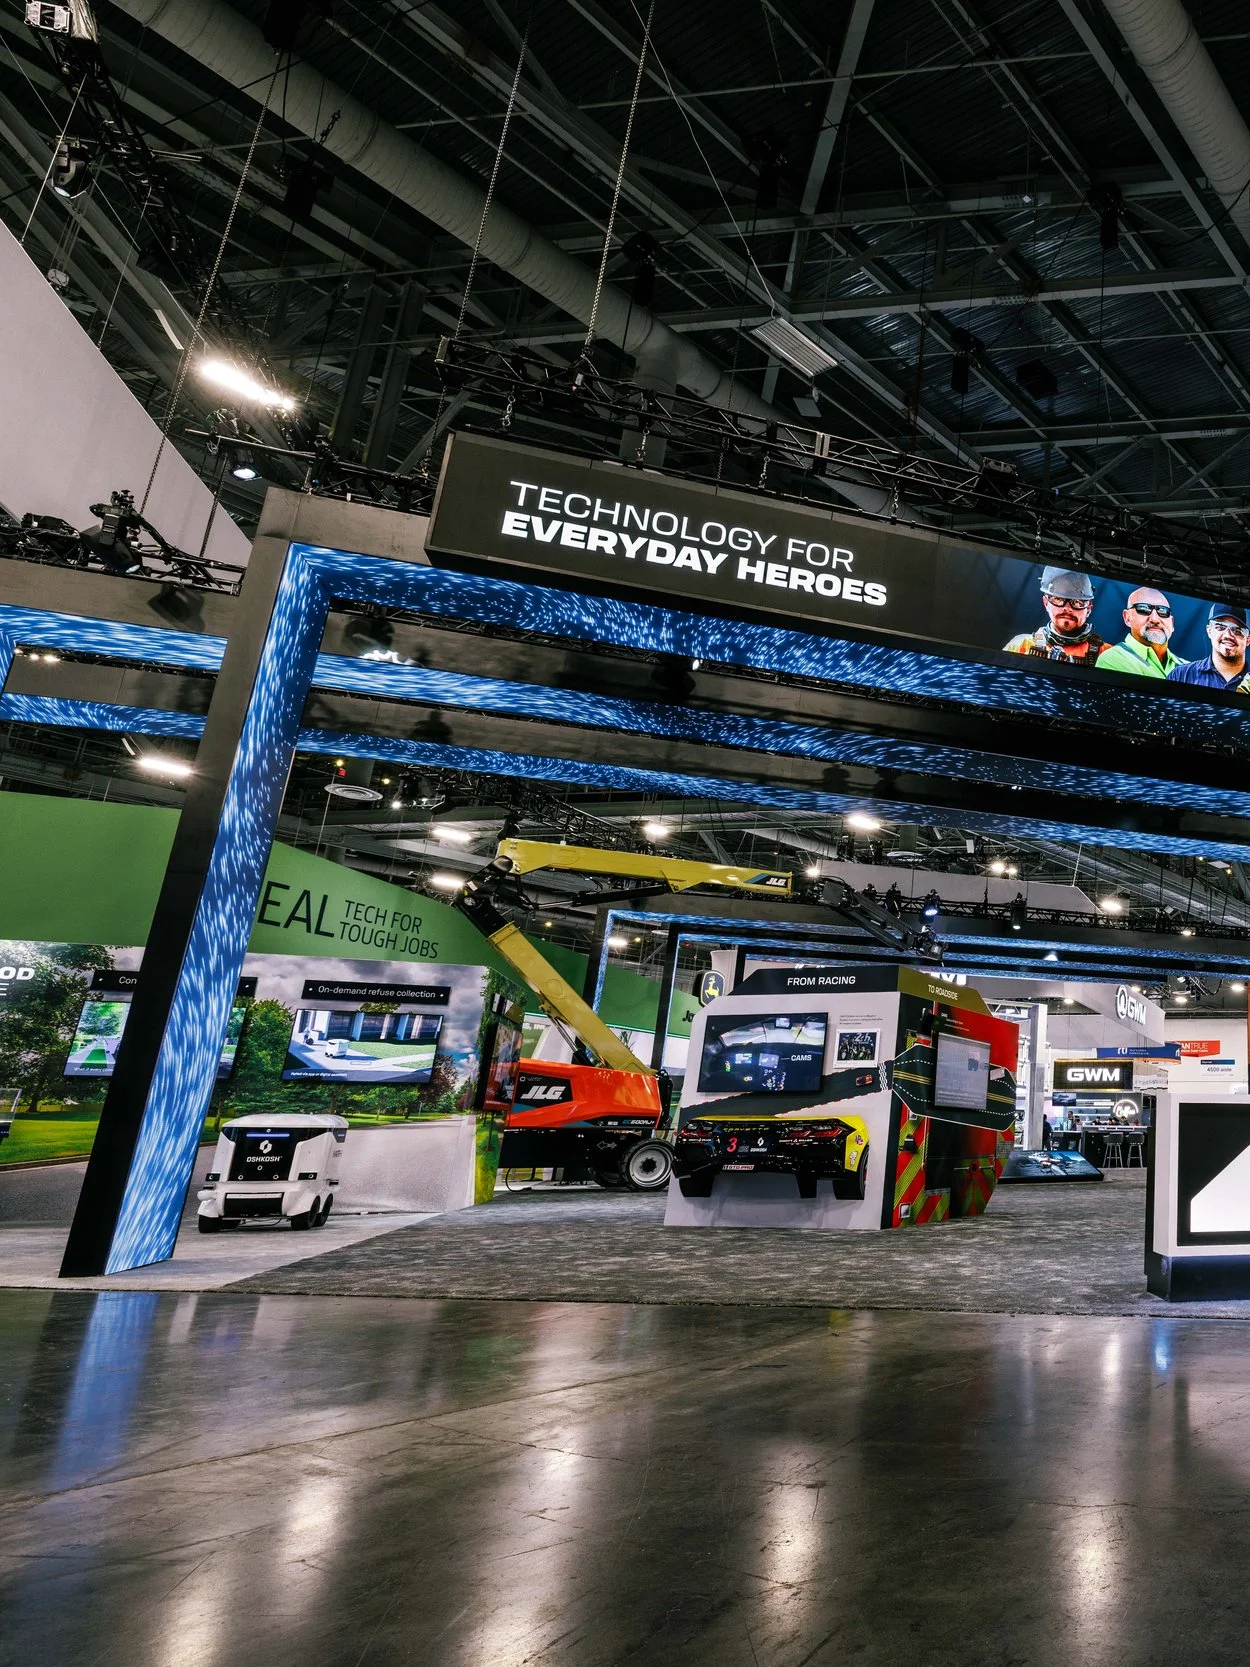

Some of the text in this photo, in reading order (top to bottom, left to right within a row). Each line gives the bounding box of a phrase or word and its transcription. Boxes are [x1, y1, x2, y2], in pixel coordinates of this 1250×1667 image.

[510, 480, 854, 573] TECHNOLOGY FOR
[501, 510, 887, 606] EVERYDAY HEROES
[765, 877, 786, 887] JLG
[344, 900, 423, 935] TECH FOR
[339, 921, 439, 959] TOUGH JOBS
[787, 975, 856, 986] FROM RACING
[318, 985, 436, 998] On-demand refuse collection
[927, 984, 958, 1001] TO ROADSIDE
[1127, 995, 1147, 1025] GWM
[790, 1054, 812, 1062] CAMS
[1066, 1067, 1121, 1082] GWM
[520, 1085, 566, 1100] JLG
[726, 1137, 738, 1153] 3
